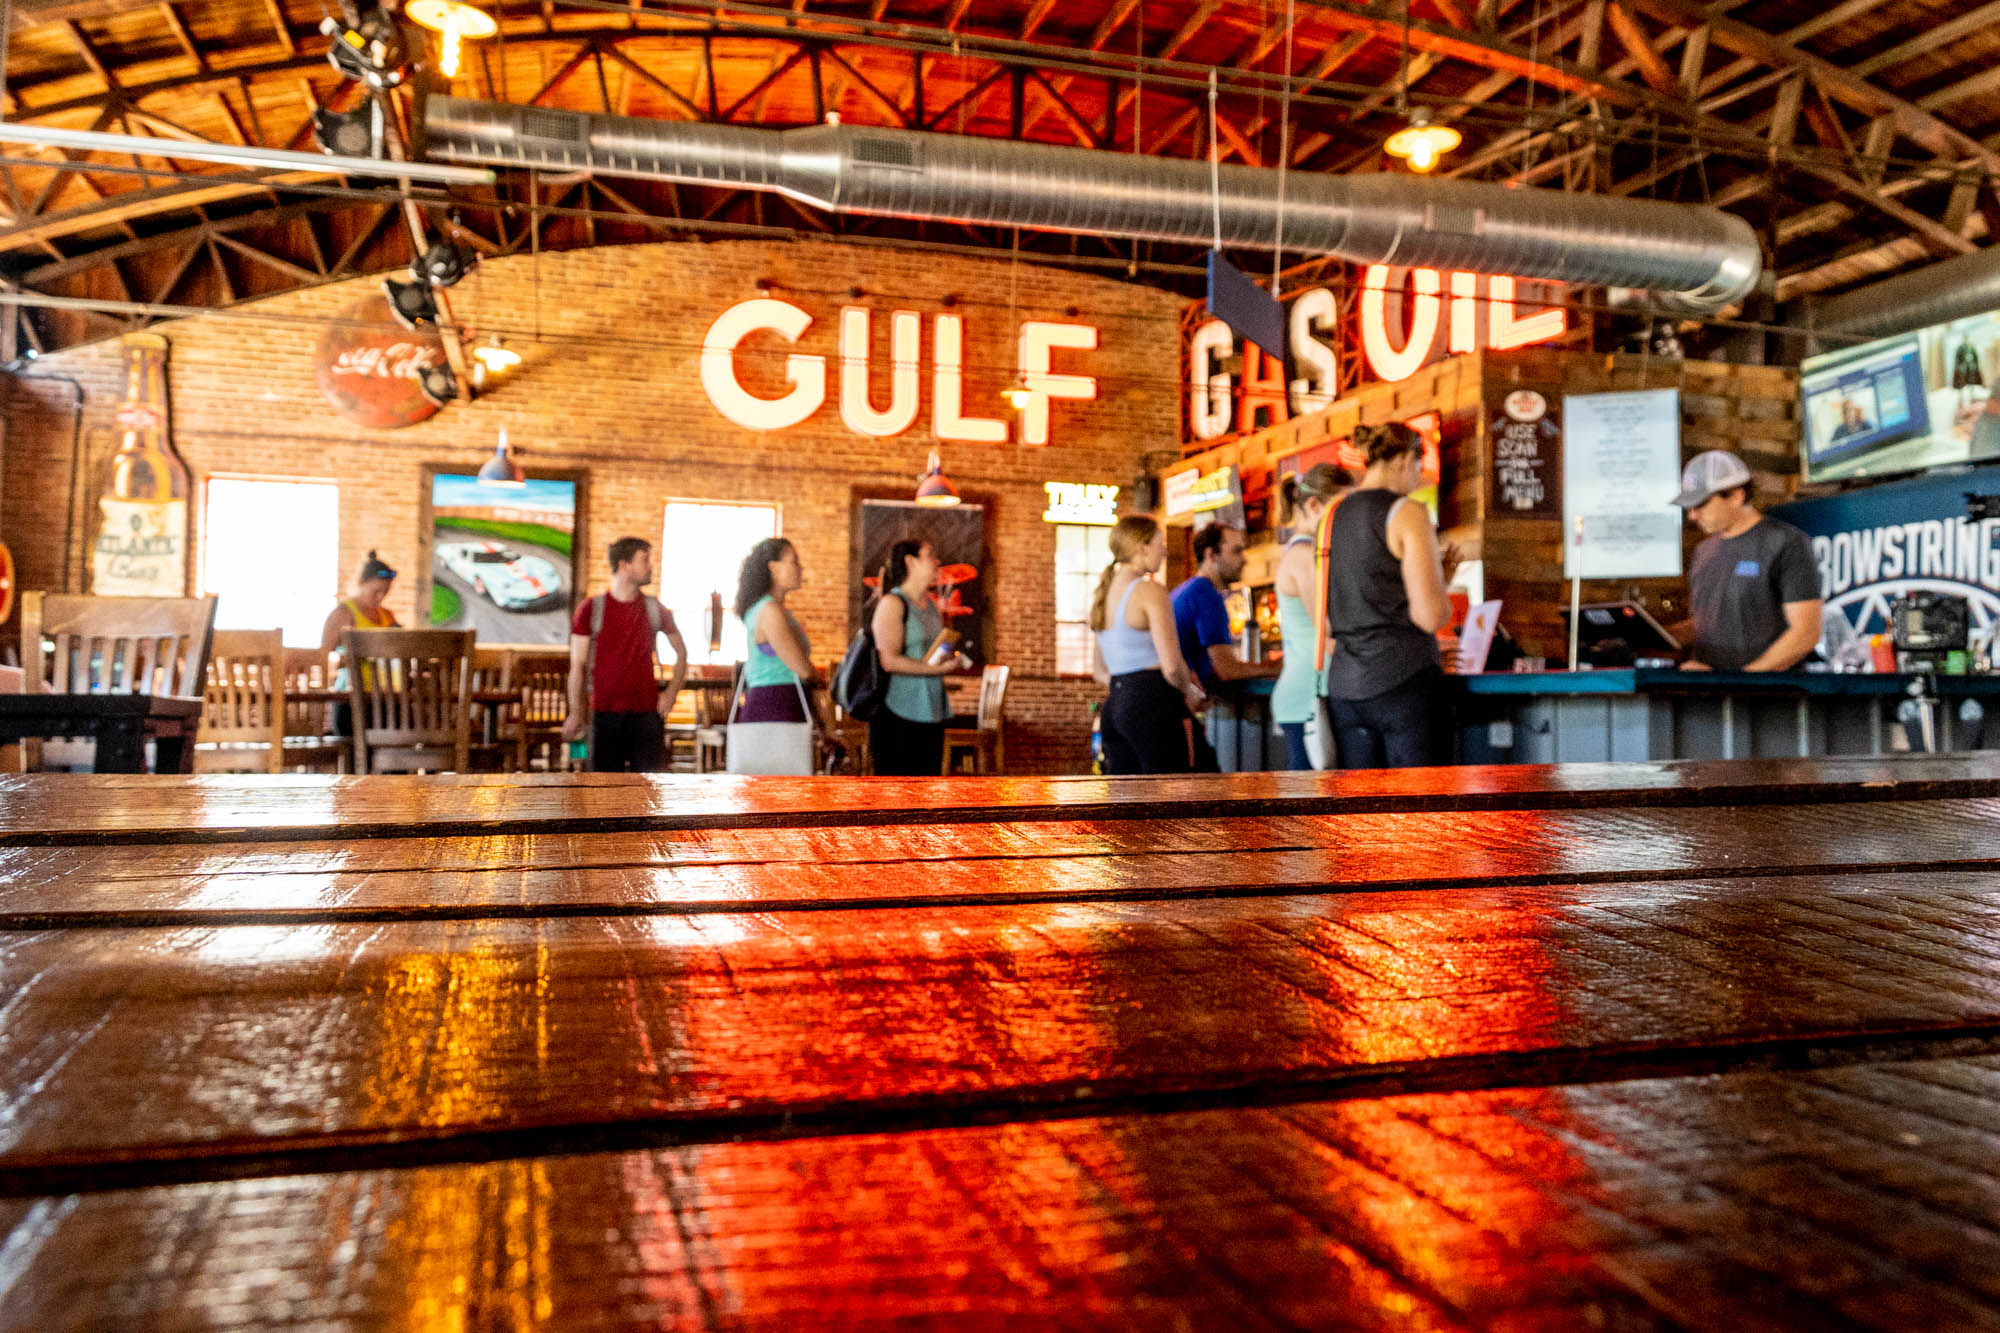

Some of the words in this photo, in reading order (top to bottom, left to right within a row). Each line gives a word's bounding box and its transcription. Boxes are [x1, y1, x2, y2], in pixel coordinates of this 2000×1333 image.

[700, 298, 1098, 446] GULF
[1190, 287, 1338, 439] GAS
[1361, 264, 1568, 383] OIL
[1813, 515, 2000, 600] BOWSTRING
